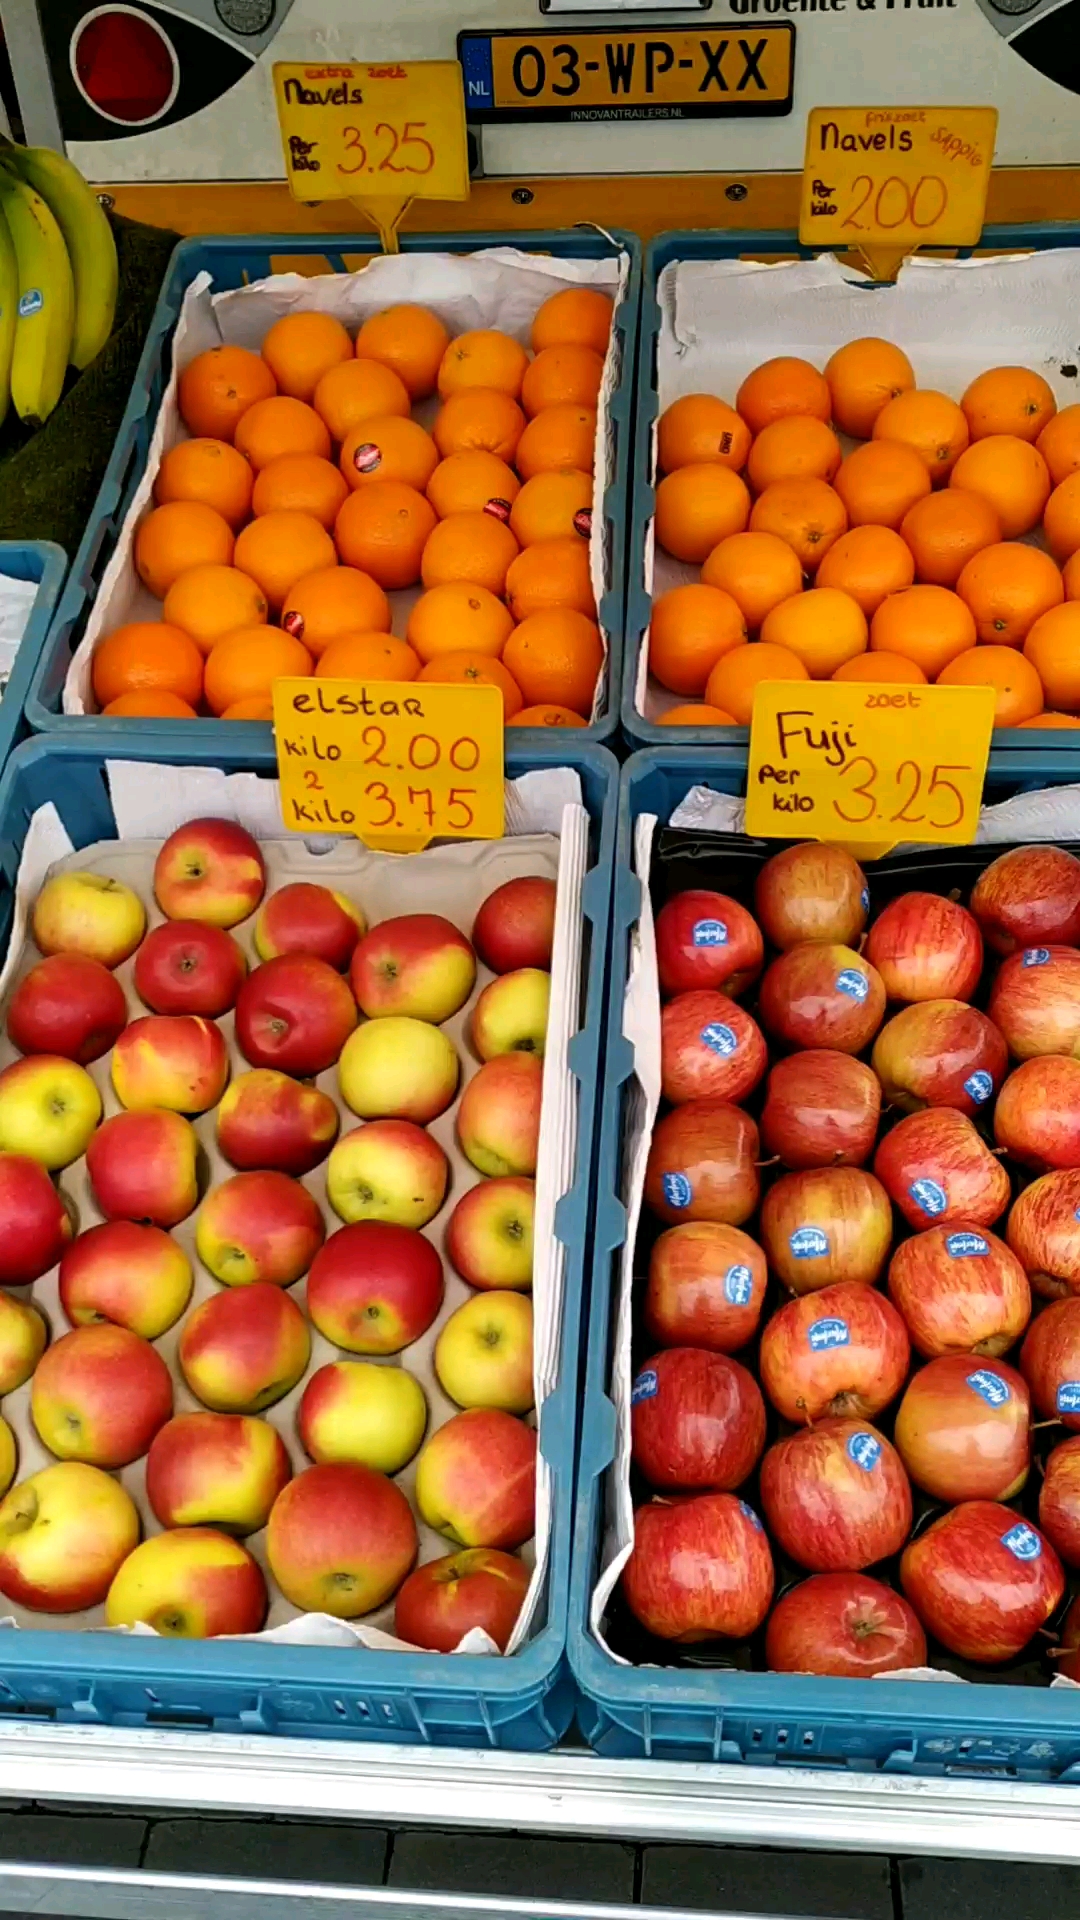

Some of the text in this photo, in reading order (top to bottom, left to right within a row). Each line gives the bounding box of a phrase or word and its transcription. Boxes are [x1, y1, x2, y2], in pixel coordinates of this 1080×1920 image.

[304, 66, 355, 80] extra
[468, 81, 490, 96] NL
[513, 39, 768, 97] 03-WP-XX
[570, 107, 685, 121] INNOVANTRAILERS.NL
[337, 122, 435, 174] 3.25
[840, 175, 948, 231] 2.00
[864, 691, 923, 708] zoet
[283, 725, 480, 771] kilo 2.00
[776, 710, 857, 767] Fuji
[303, 770, 325, 791] 2
[772, 791, 815, 813] kilo
[832, 755, 973, 829] 3.25
[291, 781, 478, 830] kilo 3.75
